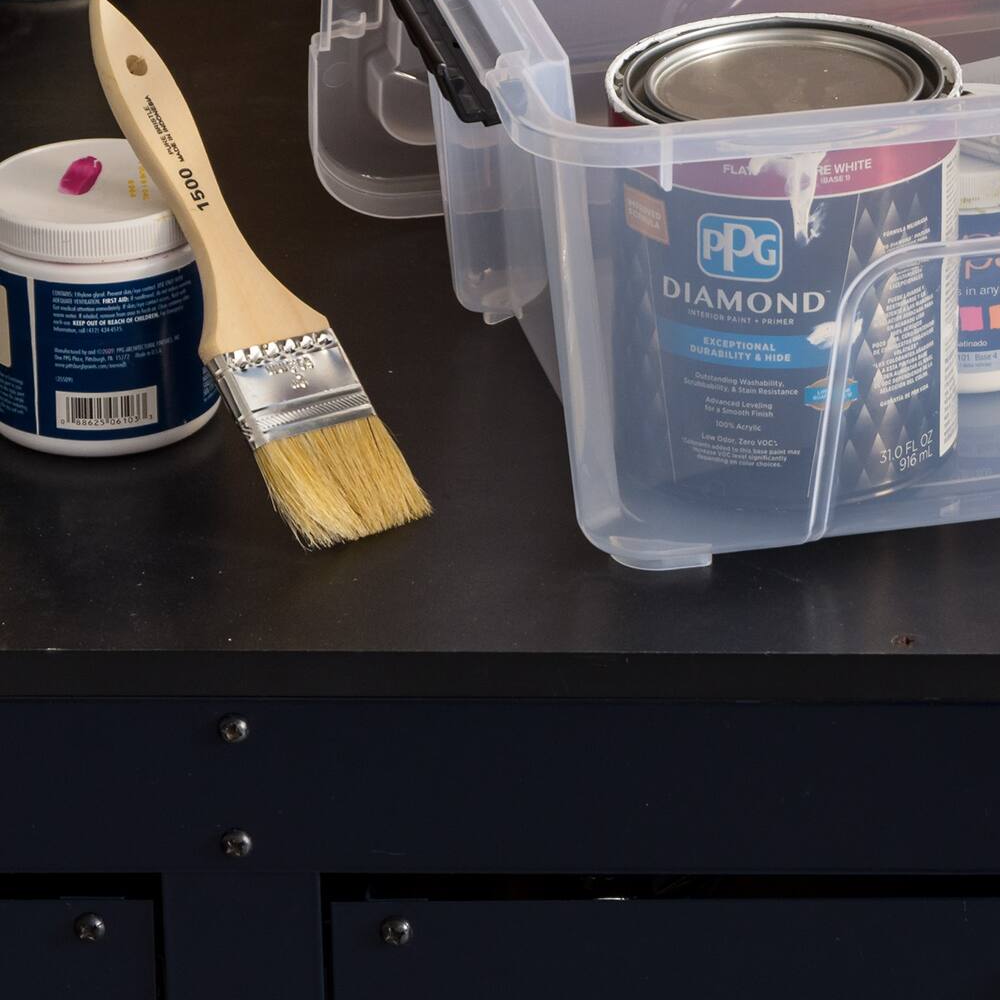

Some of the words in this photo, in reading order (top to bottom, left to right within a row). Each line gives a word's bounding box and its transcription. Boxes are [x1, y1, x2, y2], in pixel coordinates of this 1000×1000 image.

[143, 105, 162, 135] BRISTLE
[144, 94, 169, 133] INDONESIA
[160, 136, 173, 156] PURE
[171, 142, 185, 162] MADE
[833, 158, 872, 174] WHITE
[179, 167, 209, 212] 1500
[703, 222, 777, 273] PPG
[663, 275, 826, 314] DIAMOND
[966, 286, 977, 296] in
[979, 282, 1000, 297] any
[107, 318, 125, 326] REACH
[688, 309, 725, 322] INTERIOR
[727, 315, 751, 325] PAINT
[762, 318, 795, 326] PRIMER
[703, 337, 776, 352] EXCEPTIONAL
[690, 344, 751, 361] DURABILITY
[754, 353, 762, 362] &
[765, 353, 792, 362] HIDE
[974, 353, 991, 362] Base
[695, 370, 738, 386] Outstanding
[739, 377, 785, 388] Washability,
[738, 385, 757, 395] Stain
[758, 387, 799, 396] Resistance
[705, 396, 740, 408] Advanced
[741, 400, 773, 411] Leveling
[722, 407, 750, 417] Smooth
[751, 410, 774, 418] Finish
[76, 418, 105, 426] 88625
[110, 415, 140, 425] 06103
[716, 420, 734, 429] 100%
[736, 423, 761, 432] Acrylic
[701, 432, 714, 442] Low
[738, 438, 755, 447] Zero
[880, 445, 903, 464] 31.0
[906, 440, 918, 456] FL
[920, 429, 934, 447] OZ
[748, 454, 787, 463] significantly
[753, 447, 768, 455] base
[769, 448, 786, 456] paint
[899, 452, 917, 471] 916
[919, 446, 934, 462] mL
[756, 460, 783, 468] choices.
